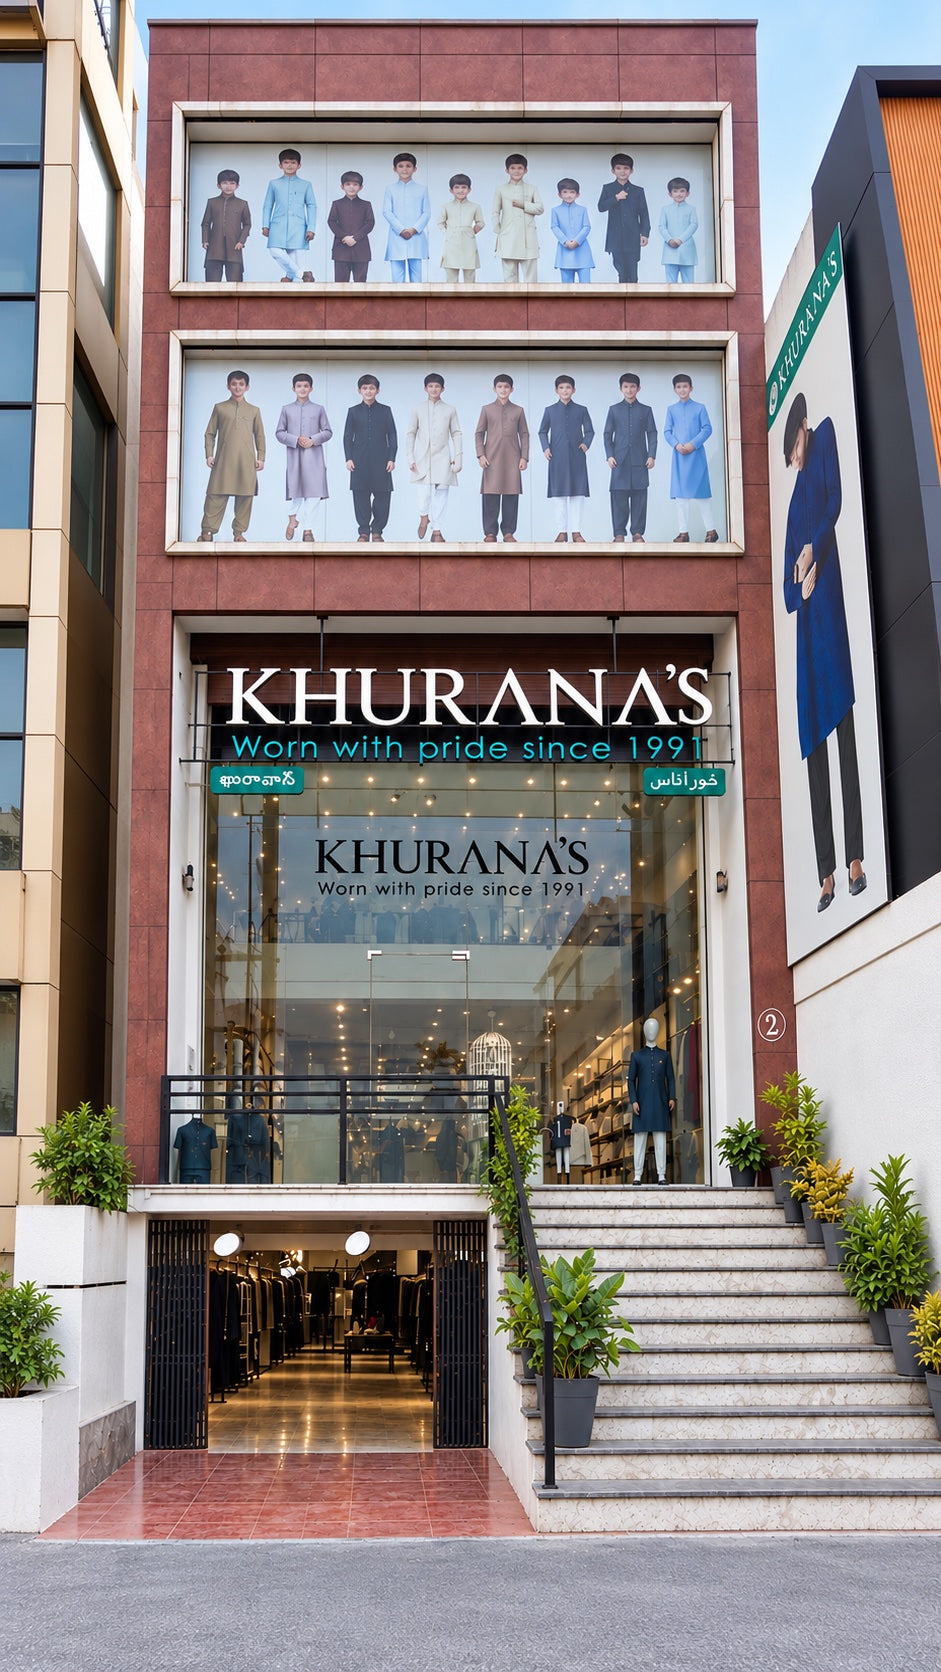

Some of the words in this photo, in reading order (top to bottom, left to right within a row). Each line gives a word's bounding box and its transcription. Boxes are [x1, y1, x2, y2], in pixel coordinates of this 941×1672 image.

[778, 250, 838, 390] KHURANA'S
[226, 664, 713, 726] KHURANA'S
[232, 735, 317, 759] Worn
[333, 735, 403, 759] with
[419, 735, 508, 764] pride
[523, 735, 611, 760] since
[629, 736, 701, 760] 1991
[315, 836, 589, 875] KHURANA'S
[317, 881, 367, 896] Worn
[375, 881, 415, 896] with
[424, 881, 474, 899] pride
[482, 882, 533, 897] since
[542, 882, 583, 897] 1991
[765, 1013, 779, 1036] 2
